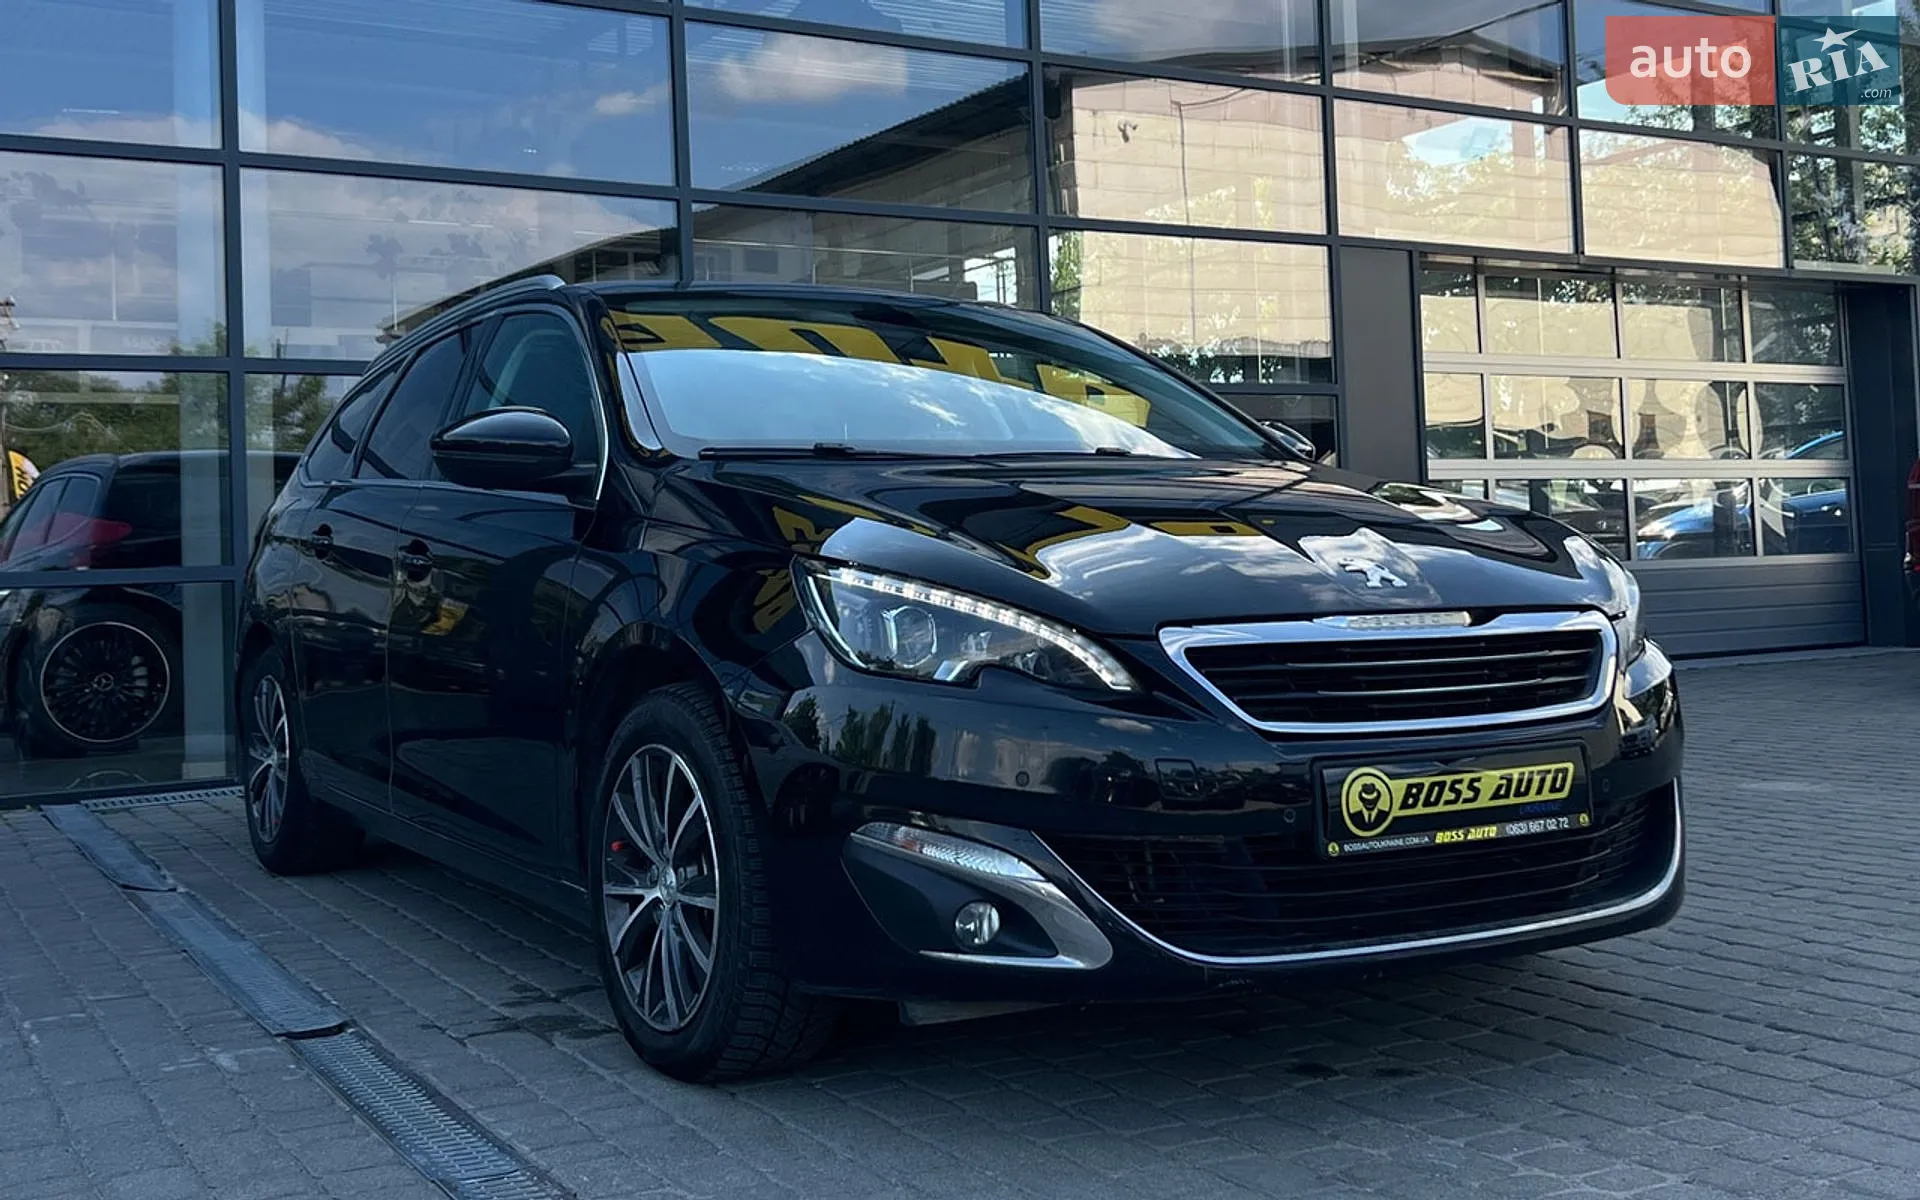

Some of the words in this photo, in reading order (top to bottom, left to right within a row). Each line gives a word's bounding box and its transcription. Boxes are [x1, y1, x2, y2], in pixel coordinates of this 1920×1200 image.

[1398, 776, 1482, 811] BOSS
[1489, 766, 1569, 801] AUTO
[1435, 831, 1465, 844] BOSS
[1467, 826, 1498, 841] AUTO
[1558, 816, 1570, 829] 72
